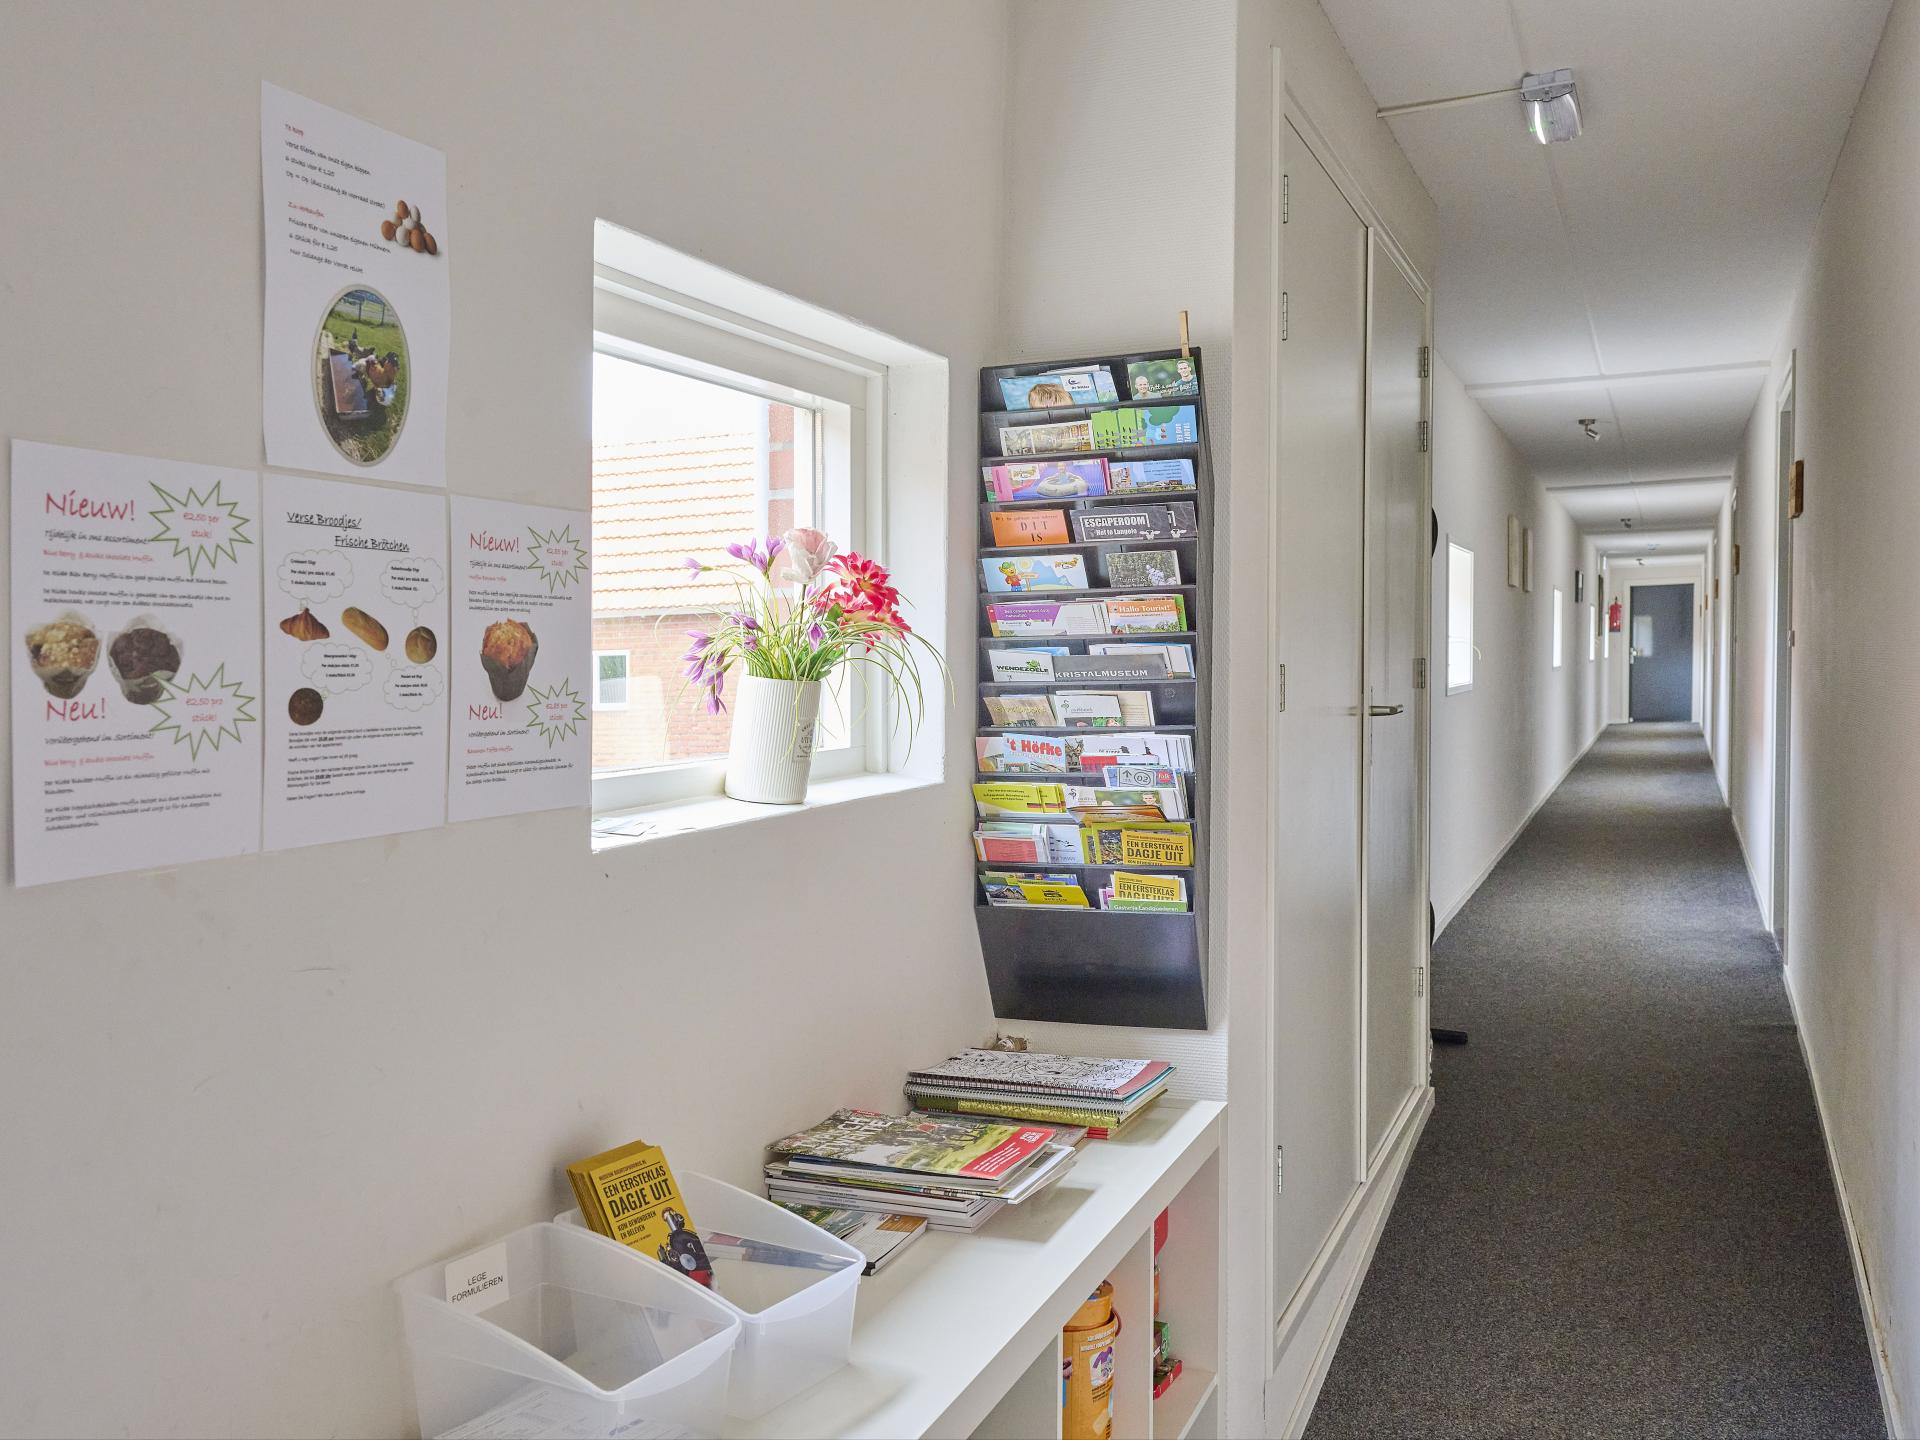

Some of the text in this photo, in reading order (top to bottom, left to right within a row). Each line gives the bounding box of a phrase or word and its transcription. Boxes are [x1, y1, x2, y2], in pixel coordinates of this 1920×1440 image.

[45, 489, 135, 521] Nieuw!
[287, 511, 314, 524] Verse
[1084, 516, 1146, 528] ESCAPEROOM
[334, 535, 410, 551] Frische Brötchen
[470, 531, 520, 553] Nieuw!
[1119, 604, 1170, 613] Hallo Tourist!
[1055, 670, 1148, 678] KRISTALMUSEUM
[46, 697, 106, 722] Neu!
[469, 702, 503, 721] Neu!
[1021, 740, 1062, 757] Höfke
[1126, 840, 1184, 852] EEN EERSTEKLAS
[1127, 847, 1183, 862] DAGJE UIT
[1119, 883, 1175, 897] EEN EERSTEKLAS
[603, 1165, 666, 1199] EEN EERSTEKLAS
[609, 1178, 672, 1218] DAGJE UIT
[451, 1271, 504, 1303] LEGE FORMULIEREN
